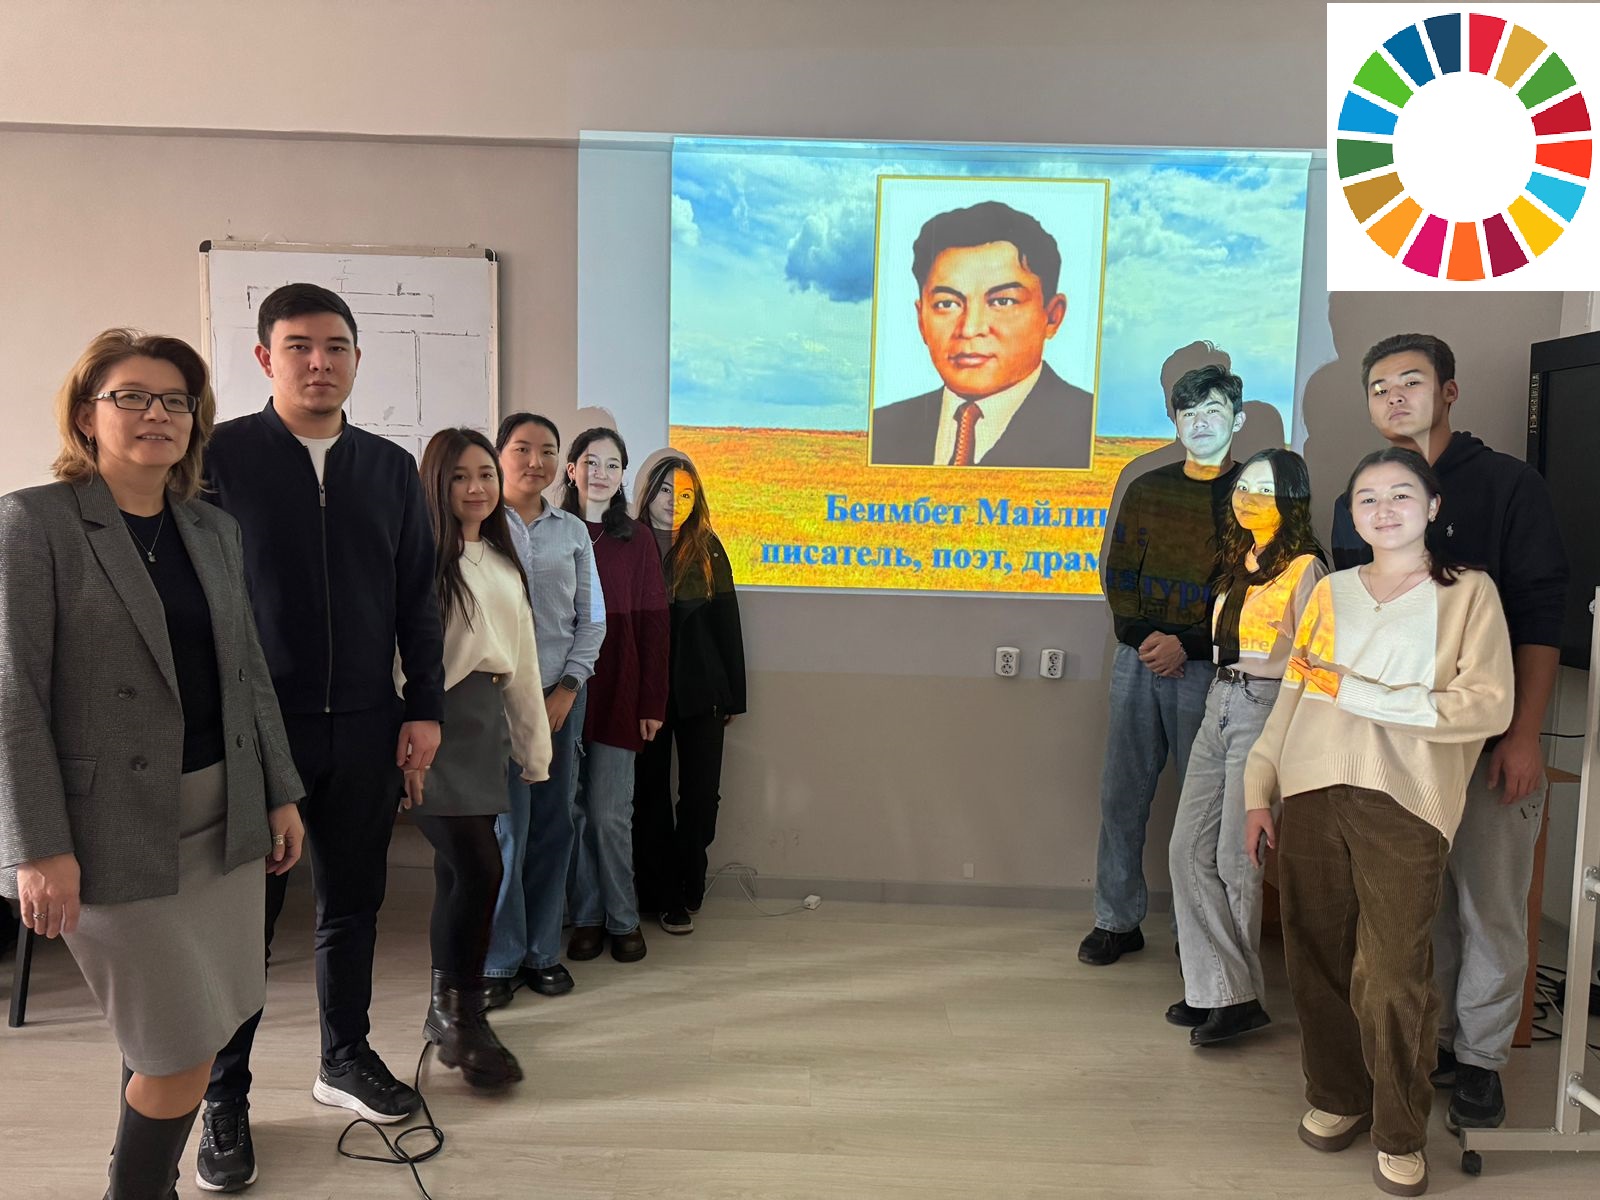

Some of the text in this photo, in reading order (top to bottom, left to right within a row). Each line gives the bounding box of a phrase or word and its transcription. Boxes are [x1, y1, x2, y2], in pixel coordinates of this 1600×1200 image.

[825, 494, 968, 526] Беимбет
[761, 543, 922, 573] писатель,
[932, 548, 1012, 574] поэт,
